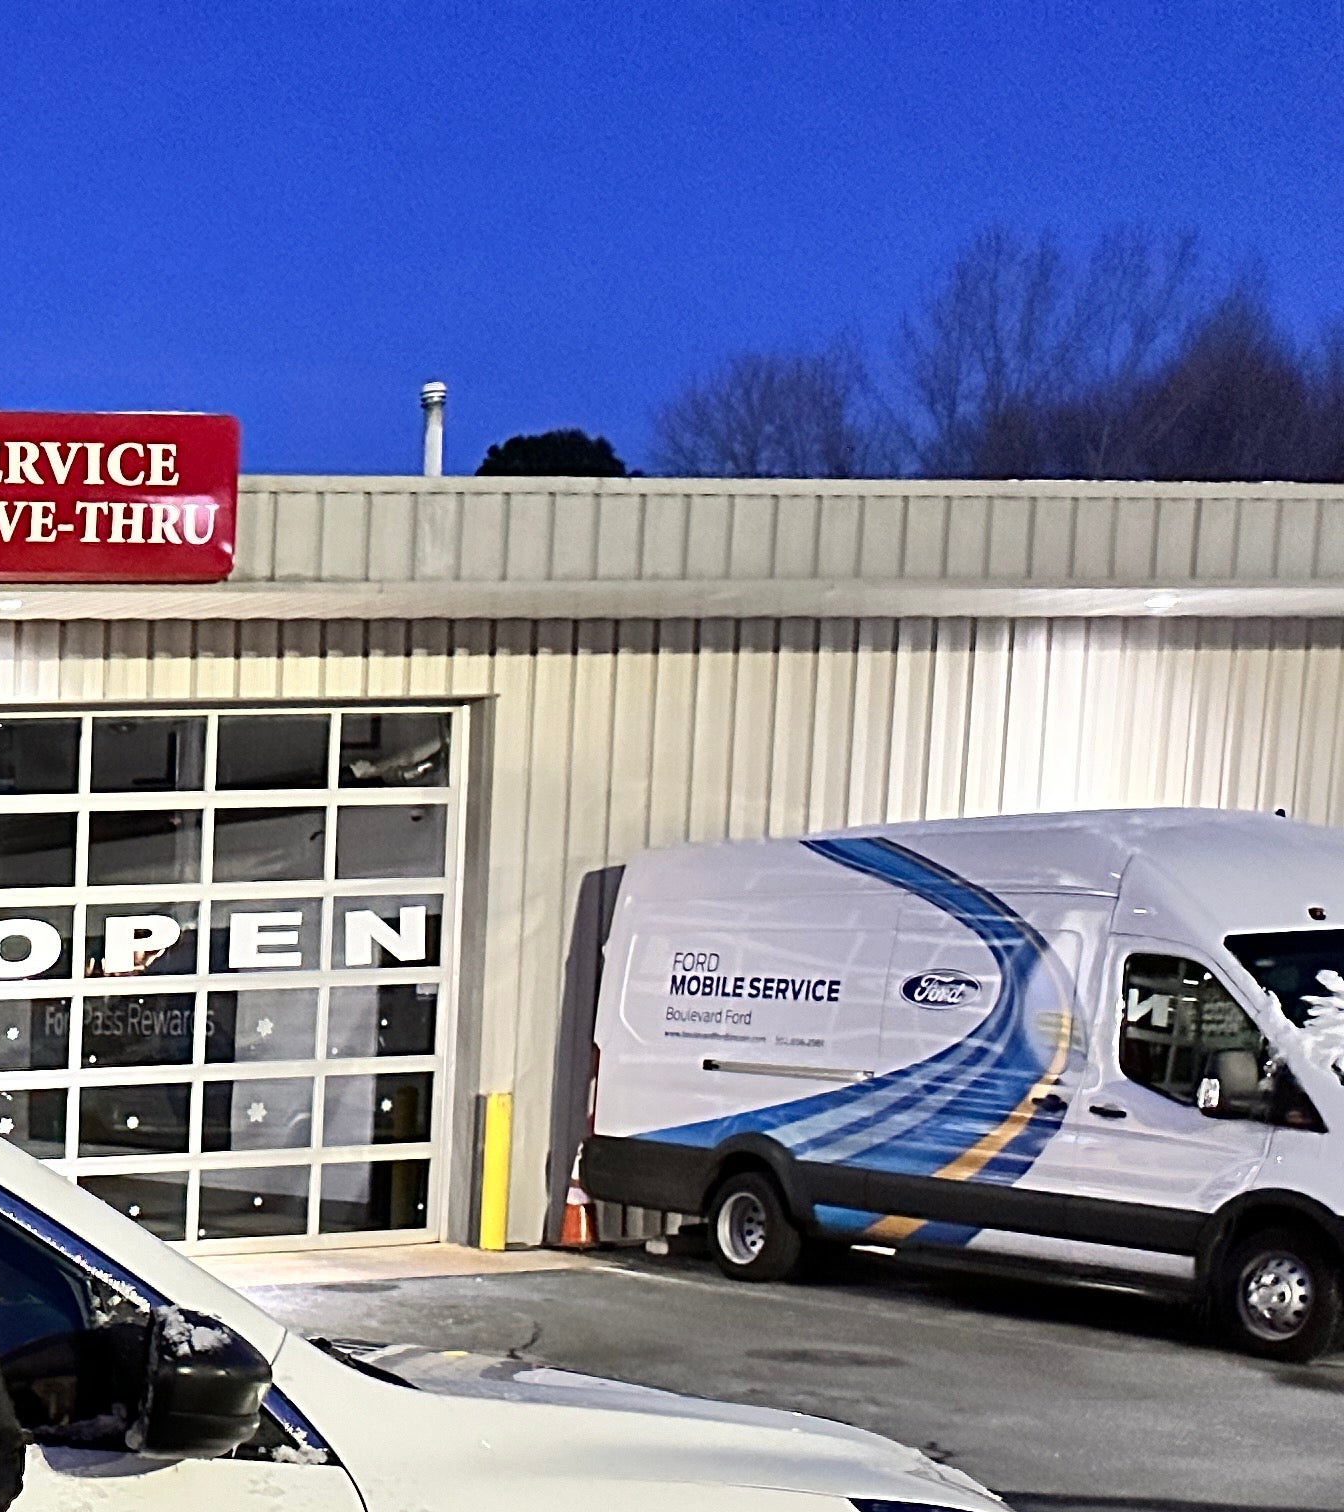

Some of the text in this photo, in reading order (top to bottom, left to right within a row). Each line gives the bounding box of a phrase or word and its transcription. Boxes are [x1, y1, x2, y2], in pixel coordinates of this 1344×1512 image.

[672, 952, 720, 972] FORD
[669, 974, 842, 1002] MOBILE SERVICE
[912, 973, 968, 1005] Ford
[127, 1001, 215, 1036] Rewars
[666, 1006, 752, 1025] Boulevard Ford
